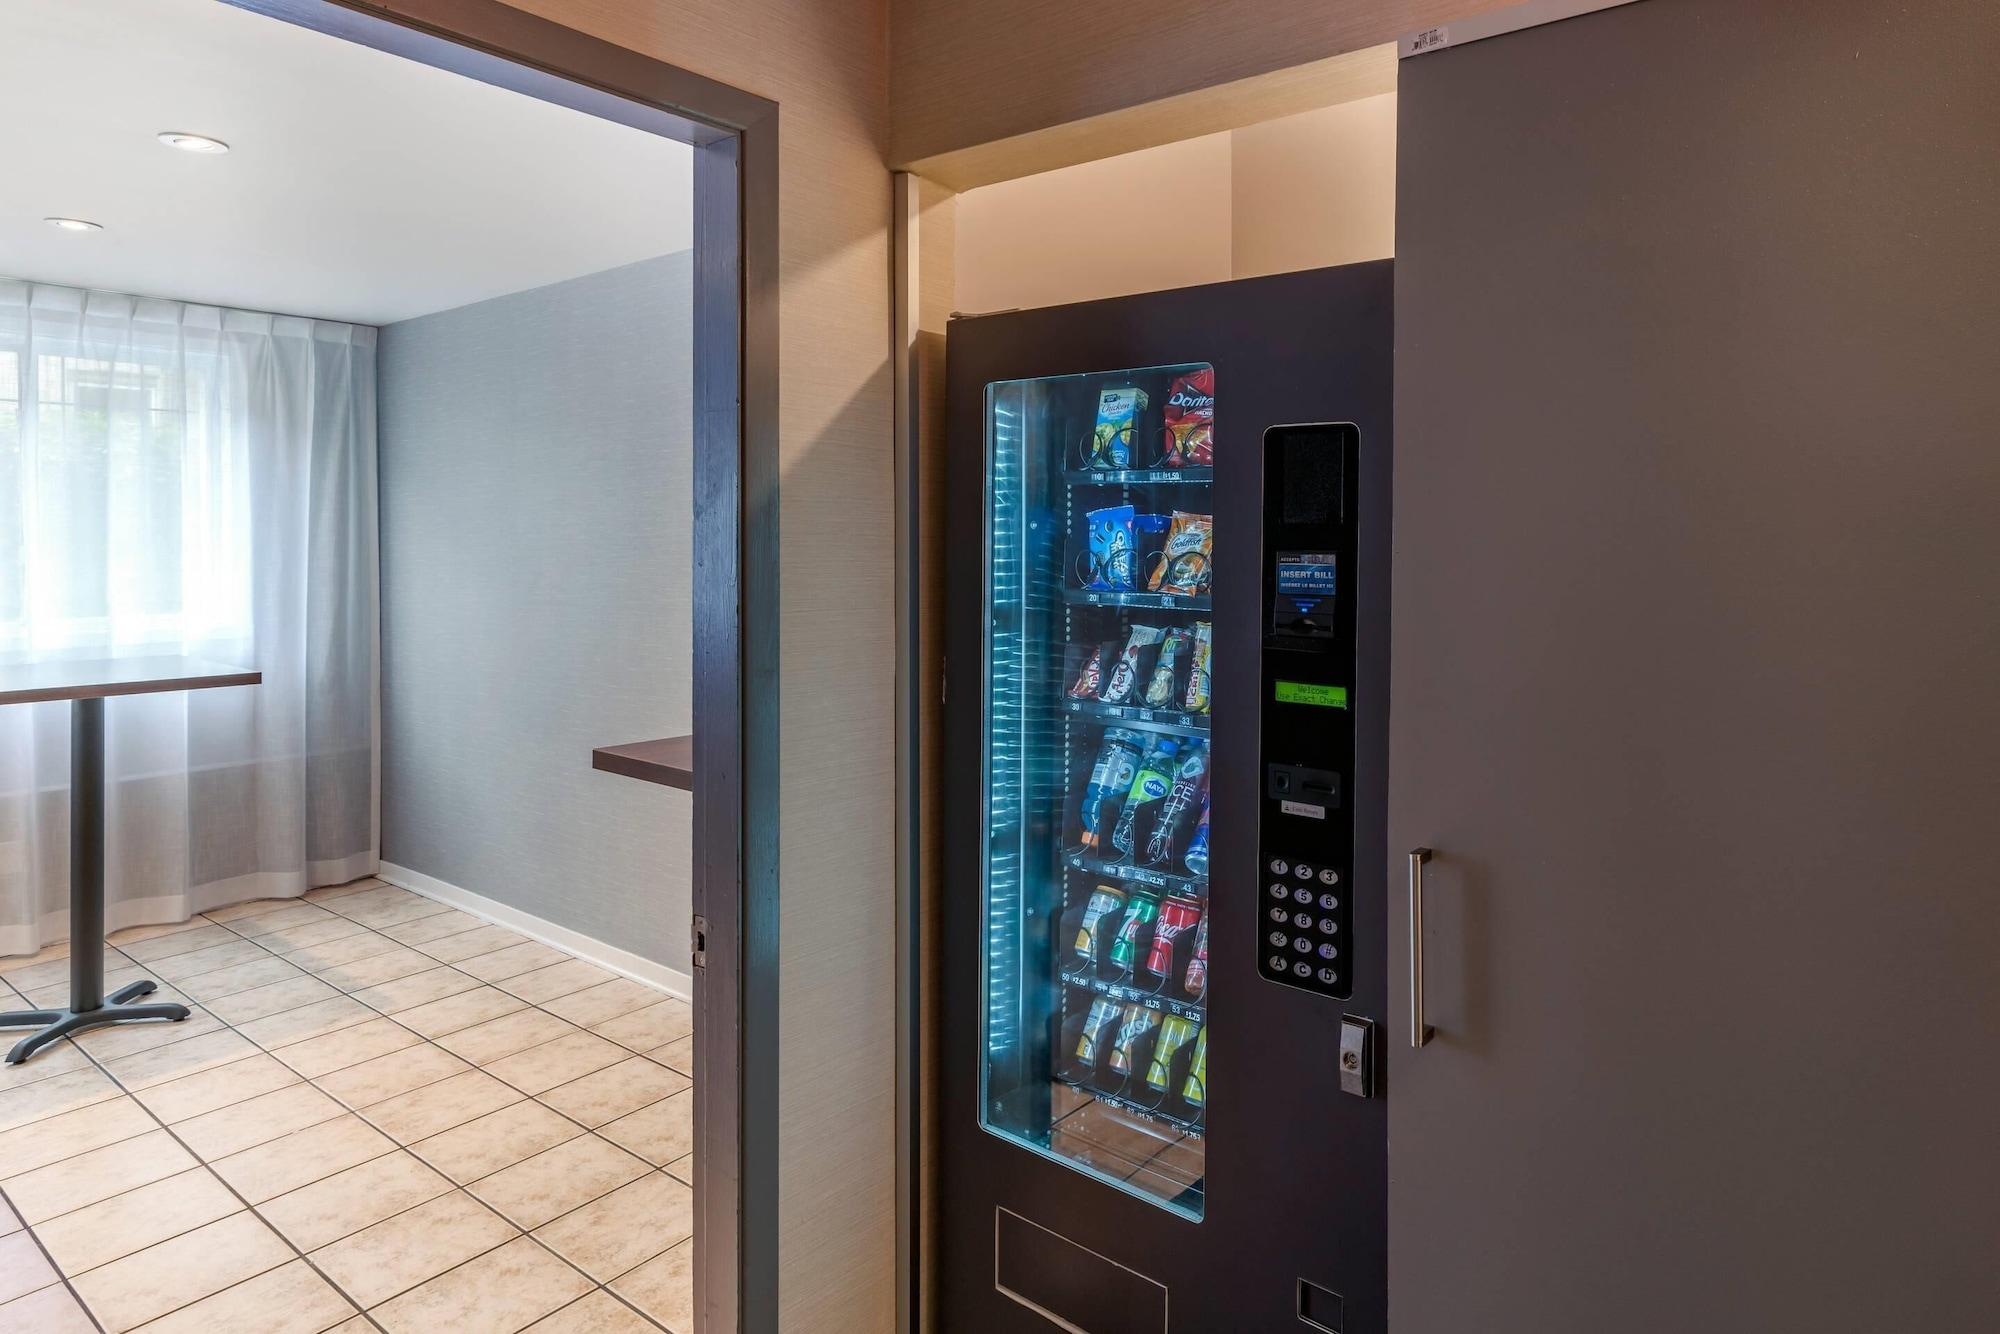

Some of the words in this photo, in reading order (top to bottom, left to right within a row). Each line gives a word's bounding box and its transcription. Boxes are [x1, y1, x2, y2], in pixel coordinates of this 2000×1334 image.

[1102, 402, 1130, 413] Chicken
[1171, 538, 1203, 549] Goldfish
[1314, 571, 1334, 579] BILL
[1089, 594, 1097, 602] 20
[1297, 685, 1329, 695] Welcome
[1294, 693, 1315, 702] Exact
[1145, 781, 1164, 794] NAYA
[1185, 1010, 1200, 1021] $1.75
